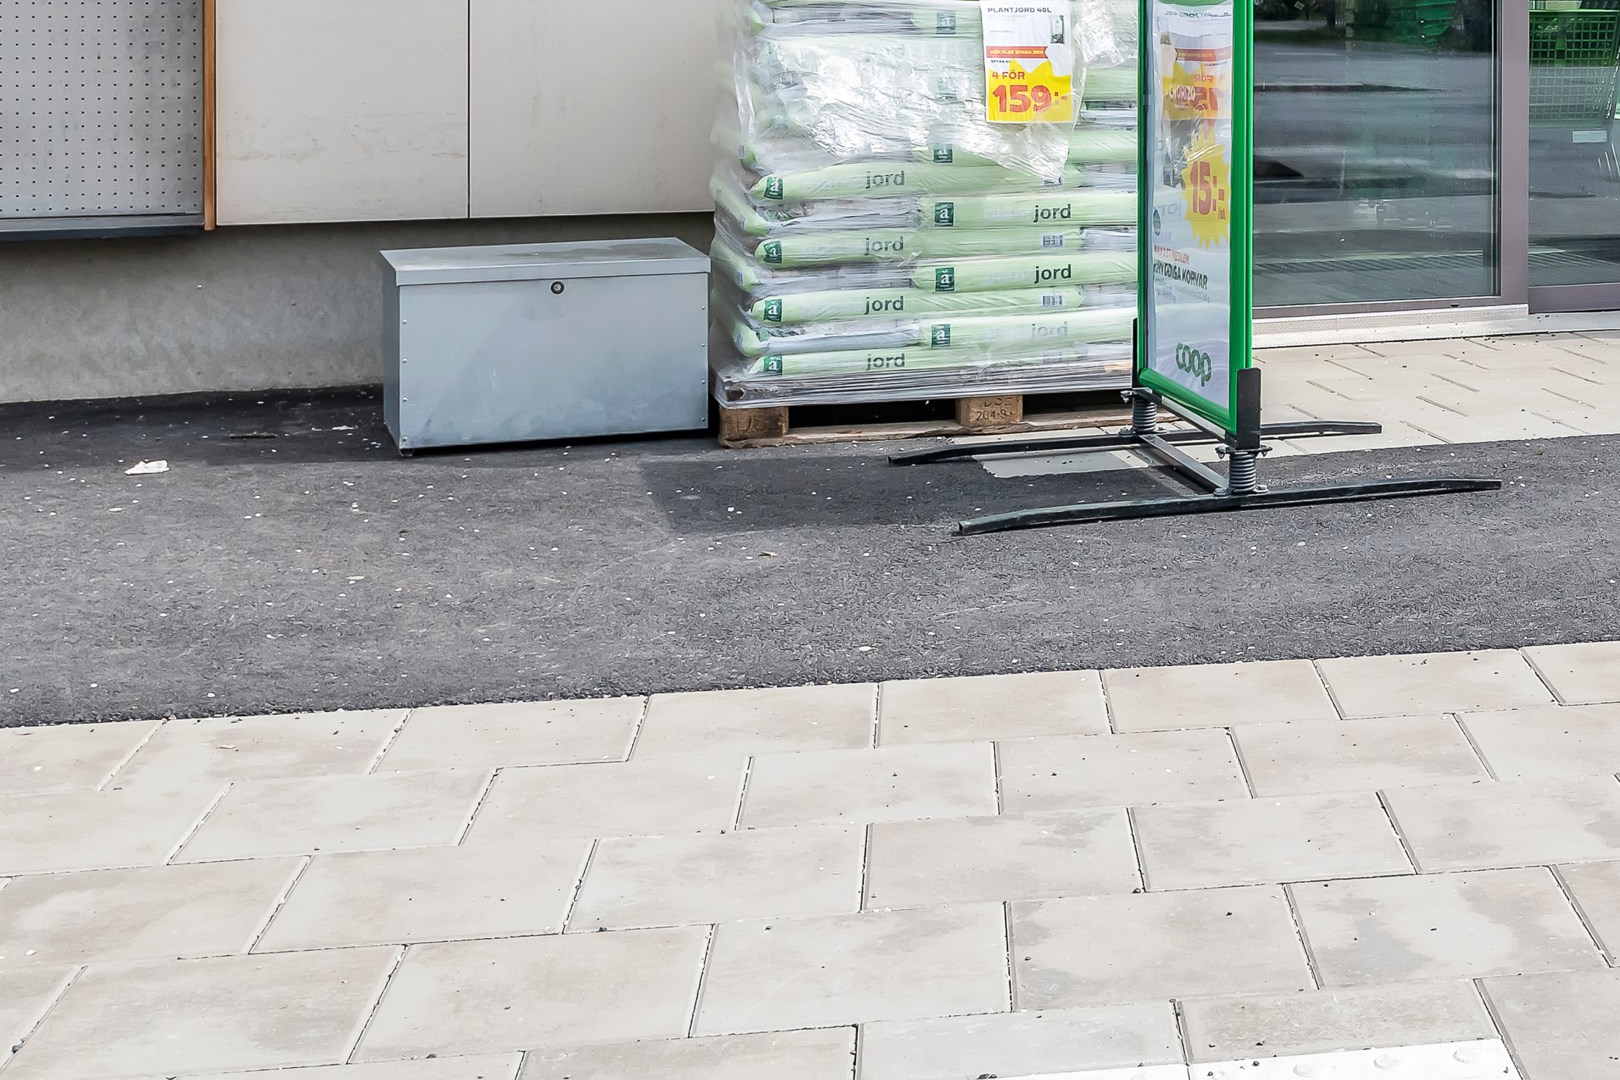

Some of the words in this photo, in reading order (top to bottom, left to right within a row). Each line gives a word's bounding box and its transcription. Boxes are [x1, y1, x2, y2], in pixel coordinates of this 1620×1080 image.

[992, 71, 999, 80] 4
[1002, 69, 1025, 80] FÖR
[1175, 342, 1212, 387] coop
